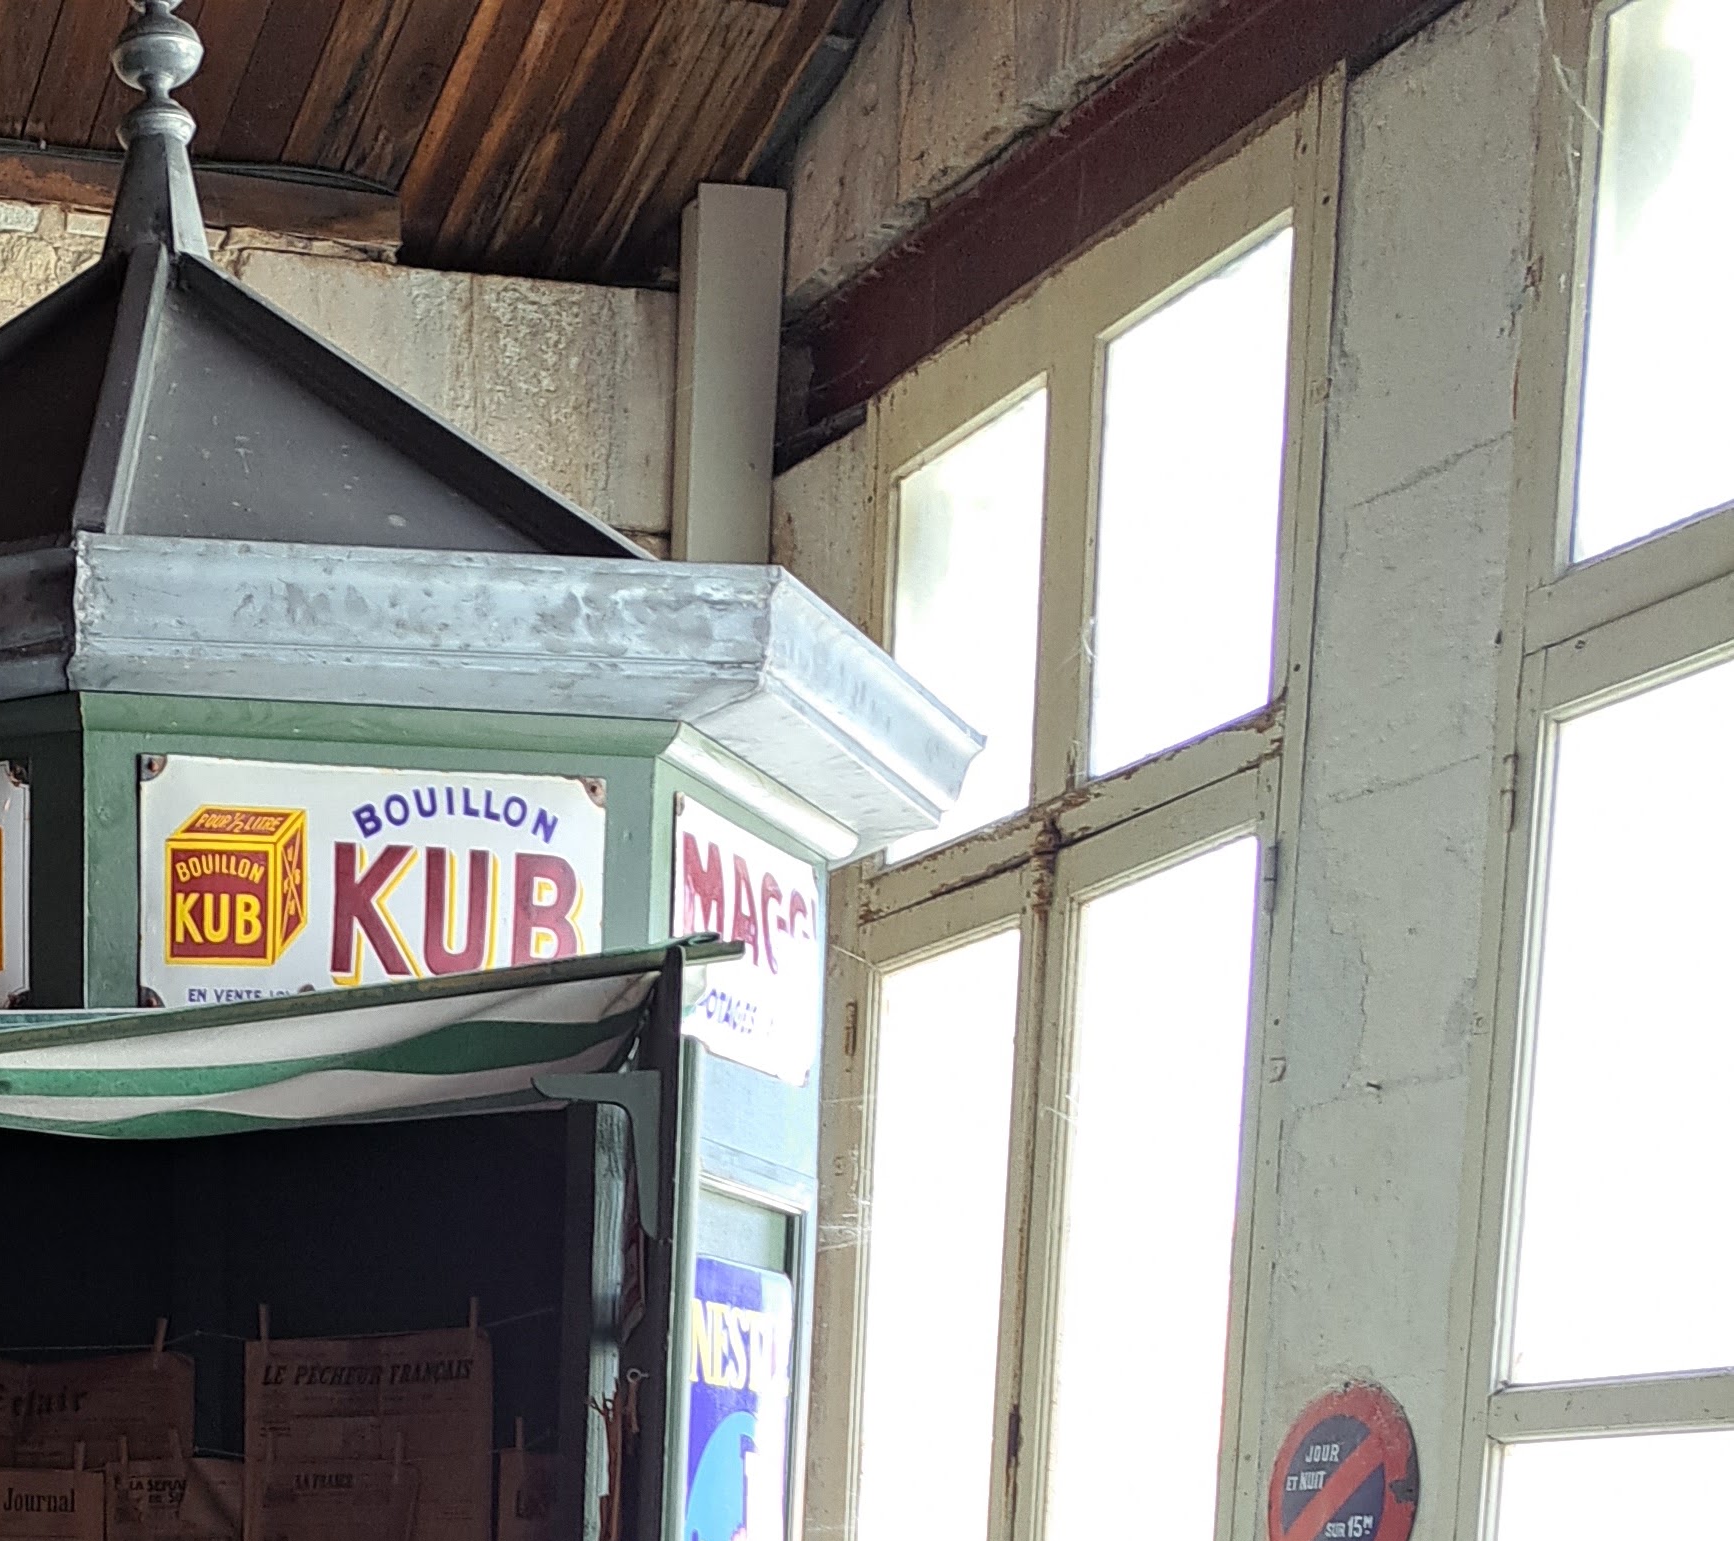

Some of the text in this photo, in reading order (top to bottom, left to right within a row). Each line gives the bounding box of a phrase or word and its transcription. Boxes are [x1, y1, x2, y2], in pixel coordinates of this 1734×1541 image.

[352, 787, 559, 844] BOUILLON
[175, 853, 264, 884] BOUILLON
[175, 892, 262, 945] KUB
[330, 841, 584, 984] KUB
[187, 988, 207, 1003] EN
[214, 989, 263, 1003] VENTE
[1305, 1444, 1339, 1463] JOUR
[1286, 1471, 1326, 1491] ET NUIT
[3, 1486, 76, 1513] Journal
[1324, 1522, 1345, 1537] SUR
